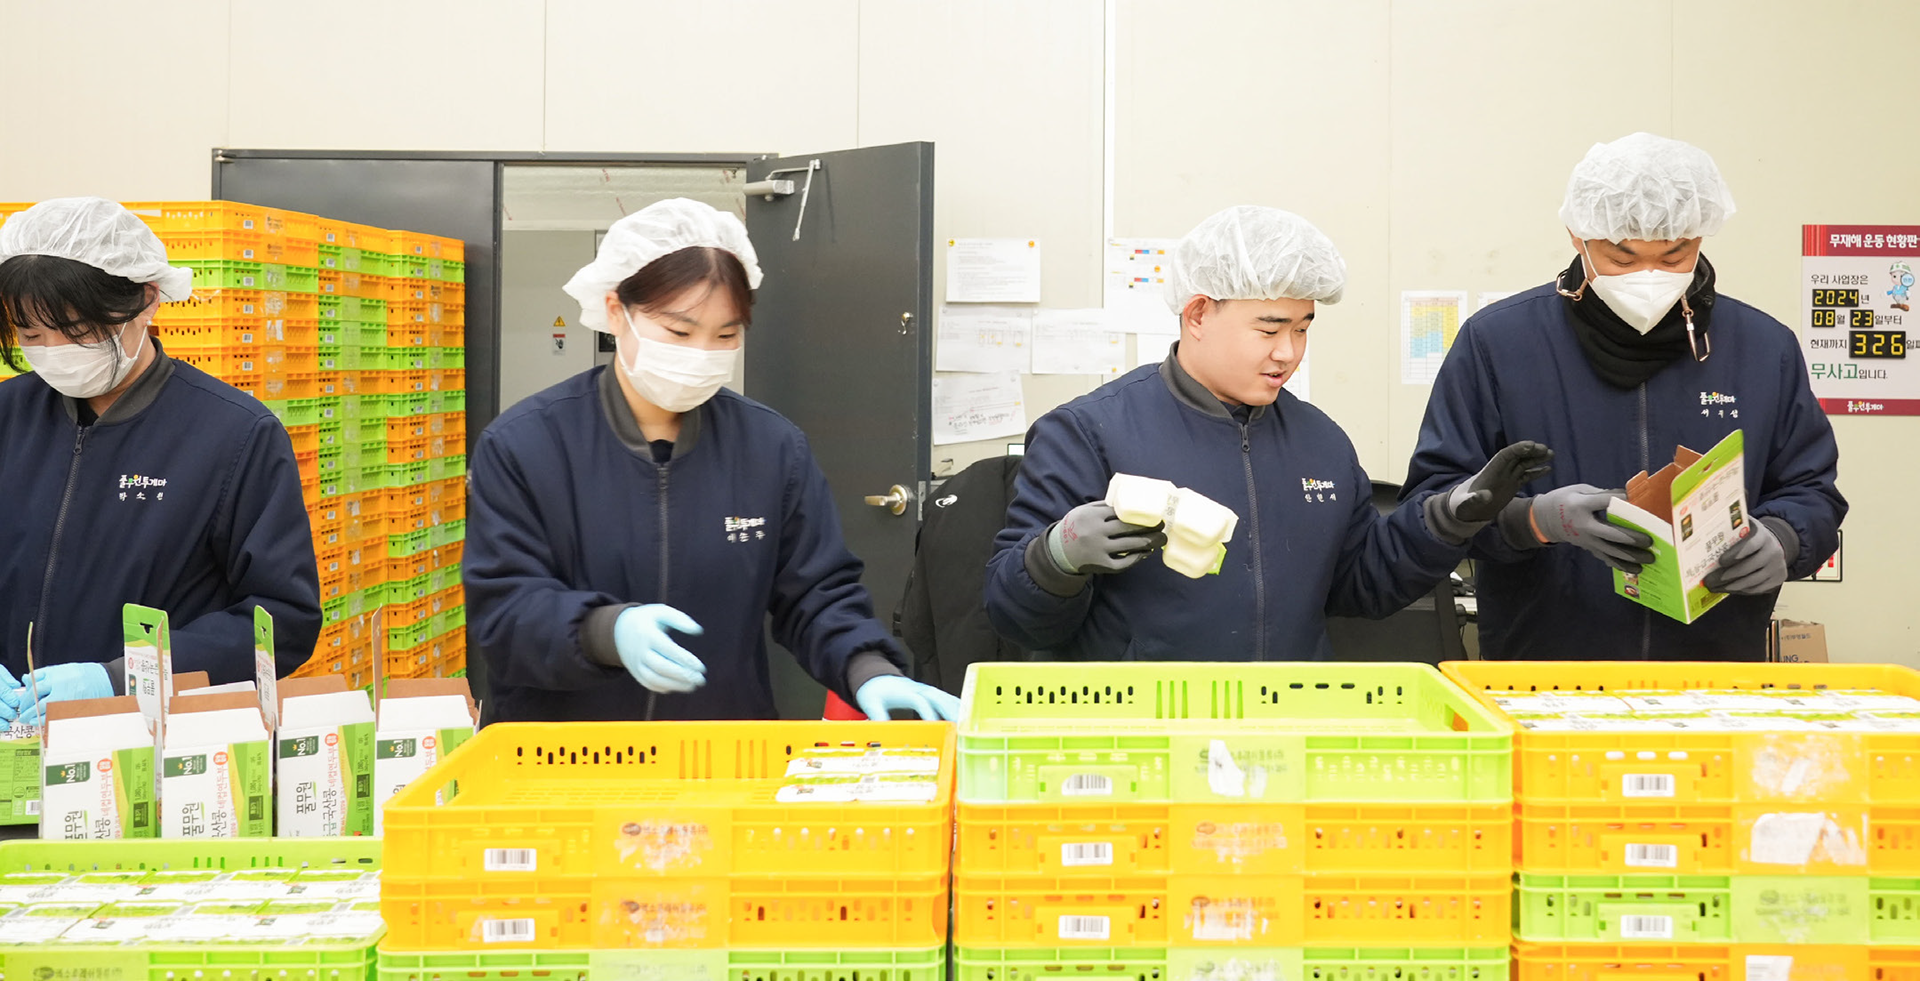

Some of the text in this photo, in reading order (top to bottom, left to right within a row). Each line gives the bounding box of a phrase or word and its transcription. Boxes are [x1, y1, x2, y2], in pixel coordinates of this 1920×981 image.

[1829, 234, 1920, 248] 무재해 운동 현황판
[1810, 275, 1869, 285] 우리 사업장은
[1810, 339, 1847, 349] 현재까지
[296, 738, 306, 756] No.1
[393, 740, 404, 758] No.1
[64, 764, 76, 783] No.1
[181, 756, 193, 775] No.1
[296, 781, 316, 814] 풀무원
[182, 802, 204, 837] 풀무원
